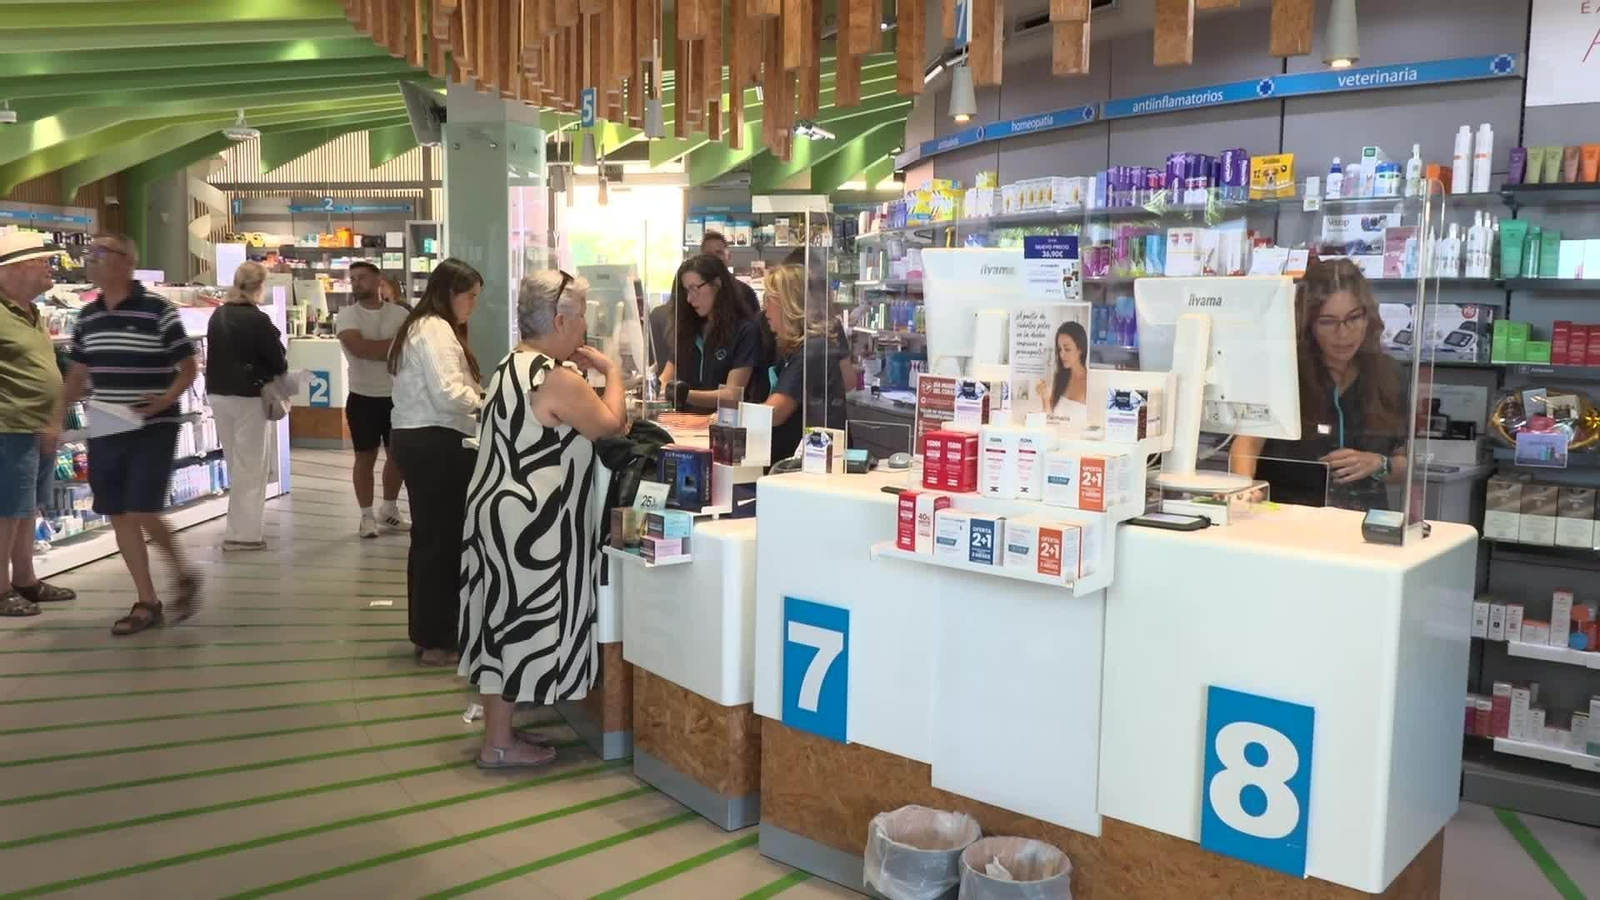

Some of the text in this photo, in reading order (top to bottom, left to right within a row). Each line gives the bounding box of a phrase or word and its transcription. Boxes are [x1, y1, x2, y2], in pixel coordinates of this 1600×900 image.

[1338, 68, 1417, 88] veterinaria
[583, 94, 592, 122] 5
[1132, 89, 1224, 113] antiinflamatorios
[324, 198, 334, 210] 2
[310, 377, 328, 402] 2
[1082, 472, 1102, 487] 2+1
[972, 533, 992, 548] 2+1
[1040, 542, 1060, 559] 2+1
[787, 620, 844, 712] 7
[1209, 721, 1300, 840] 8
